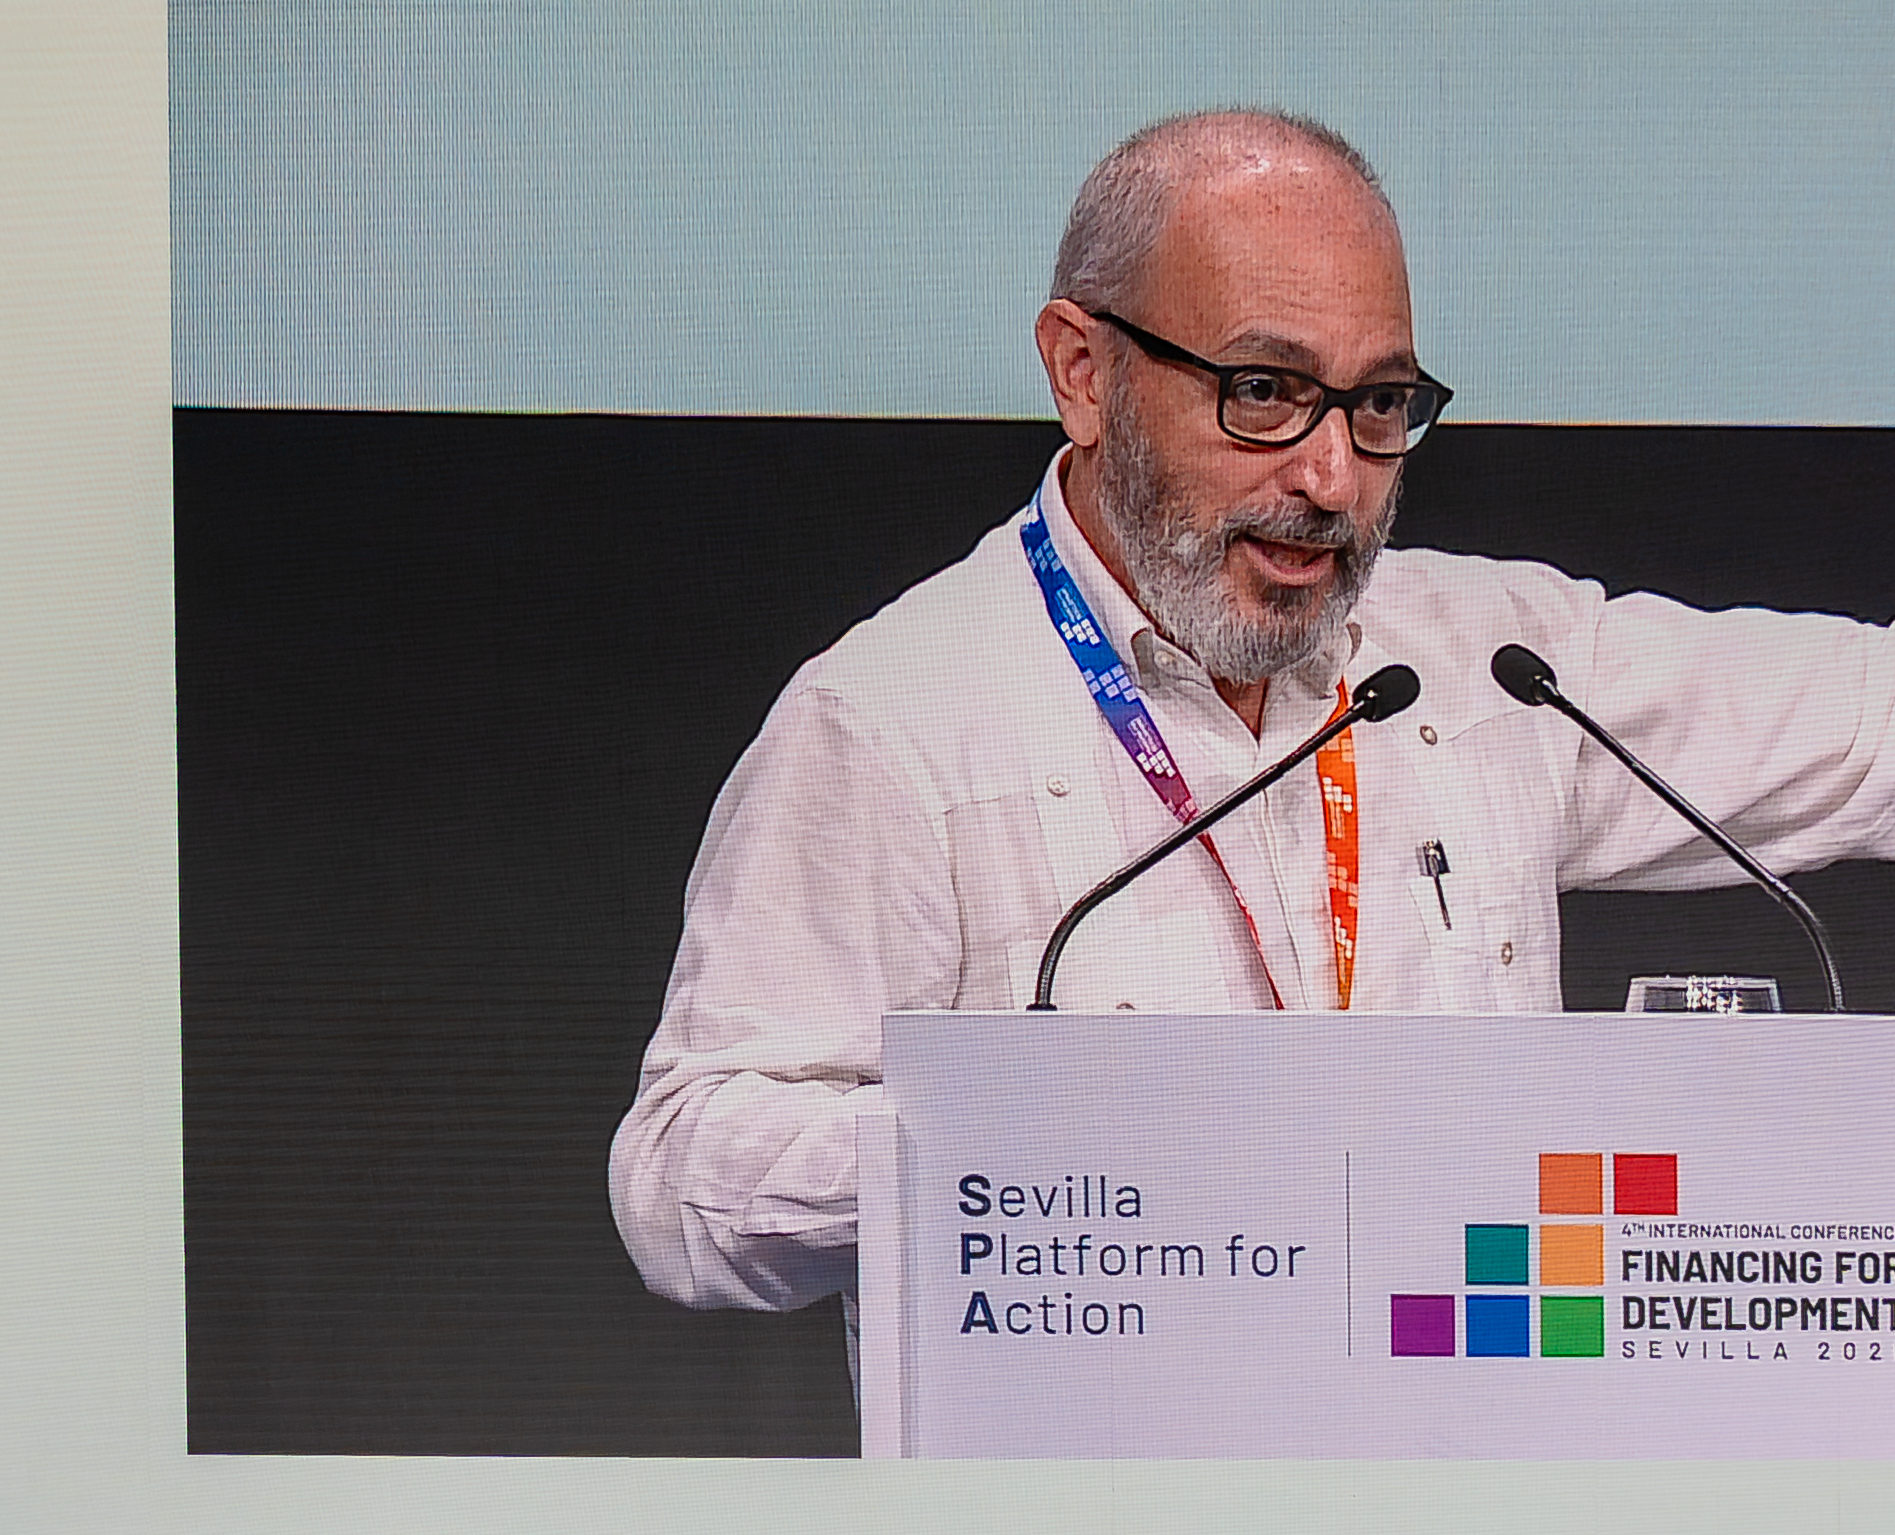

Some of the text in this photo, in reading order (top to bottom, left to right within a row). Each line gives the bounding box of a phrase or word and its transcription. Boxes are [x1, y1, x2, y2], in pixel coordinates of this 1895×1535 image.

[958, 1173, 1142, 1218] Sevilla
[1648, 1223, 1787, 1240] INTERNATIONAL
[960, 1232, 1307, 1278] Platform for
[1621, 1249, 1824, 1284] FINANCING
[960, 1290, 1145, 1336] Action
[1621, 1340, 1788, 1361] SEVILLA
